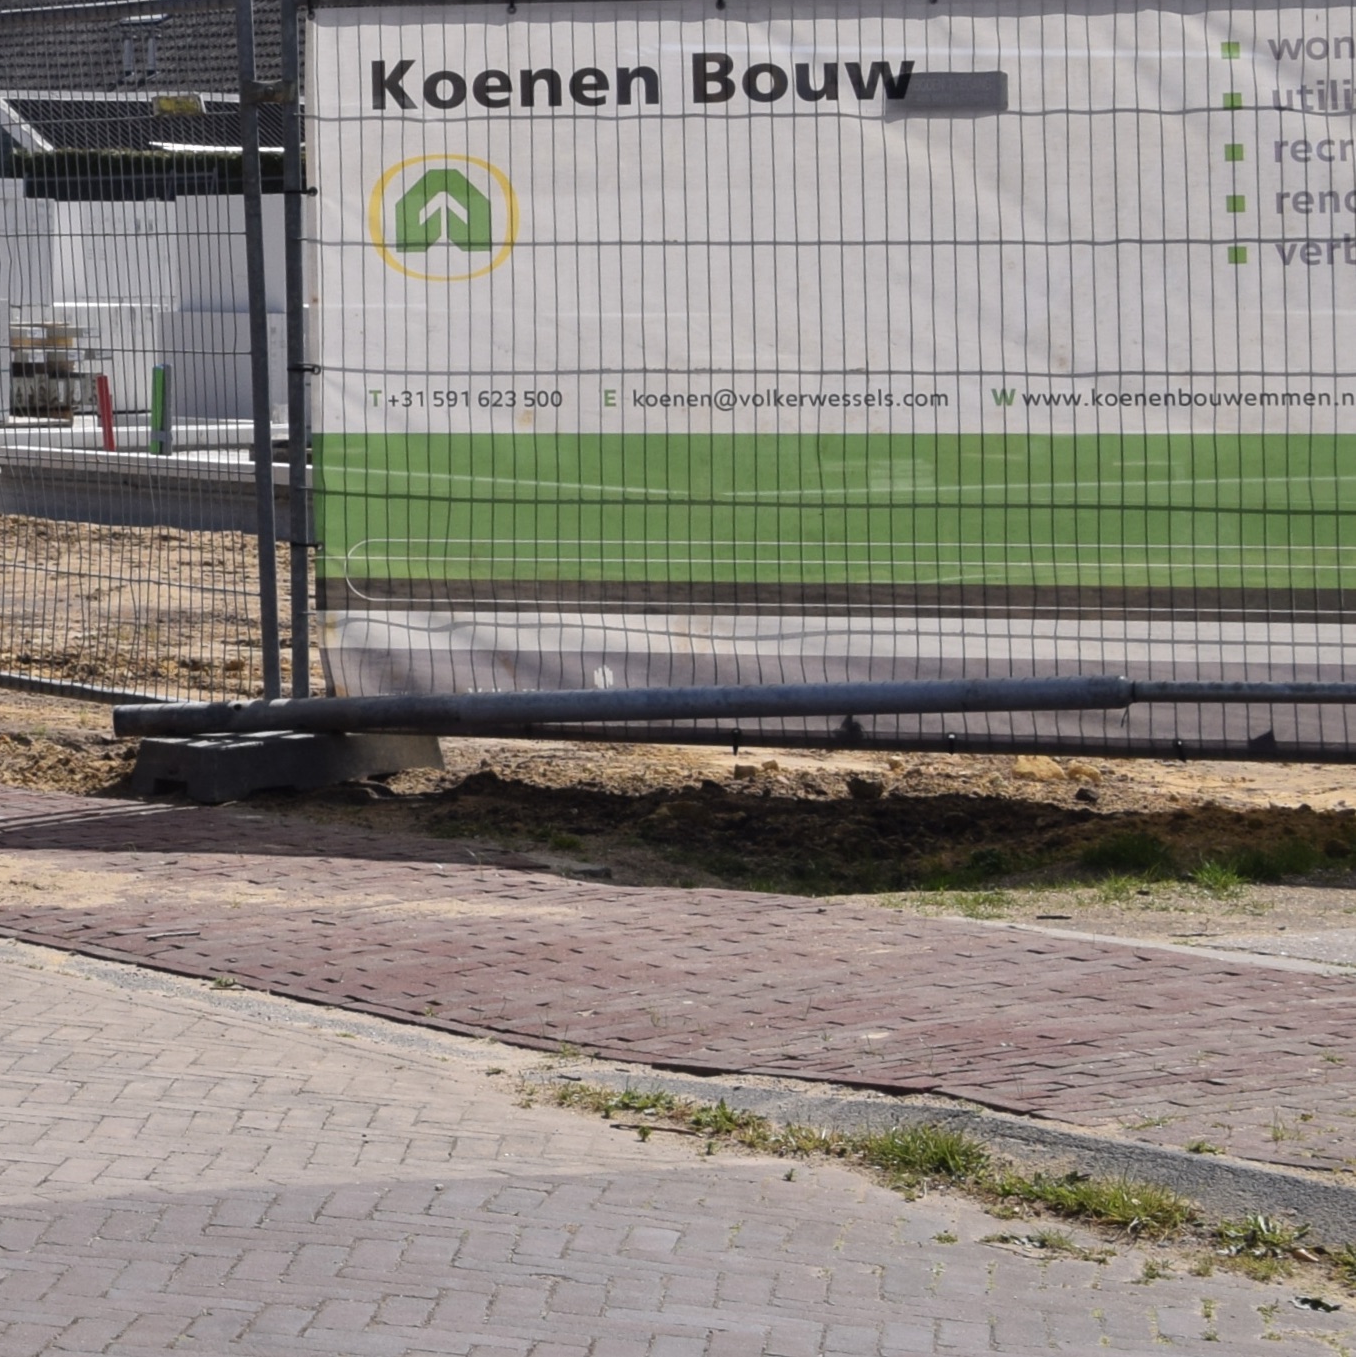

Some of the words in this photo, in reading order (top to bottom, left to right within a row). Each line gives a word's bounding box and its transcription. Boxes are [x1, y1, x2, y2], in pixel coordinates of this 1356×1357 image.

[1267, 36, 1356, 60] won
[370, 58, 660, 111] Koenen
[692, 52, 916, 104] Bouw
[1272, 79, 1356, 111] utili
[368, 390, 382, 407] T
[388, 390, 425, 407] +31
[433, 390, 470, 407] 591
[477, 390, 516, 407] 623
[523, 390, 563, 407] 500
[603, 389, 617, 407] E
[632, 388, 949, 411] koenen@volkerwessels.com
[990, 388, 1016, 407] W
[1022, 388, 1355, 407] www.koenenbouwemmen.n
